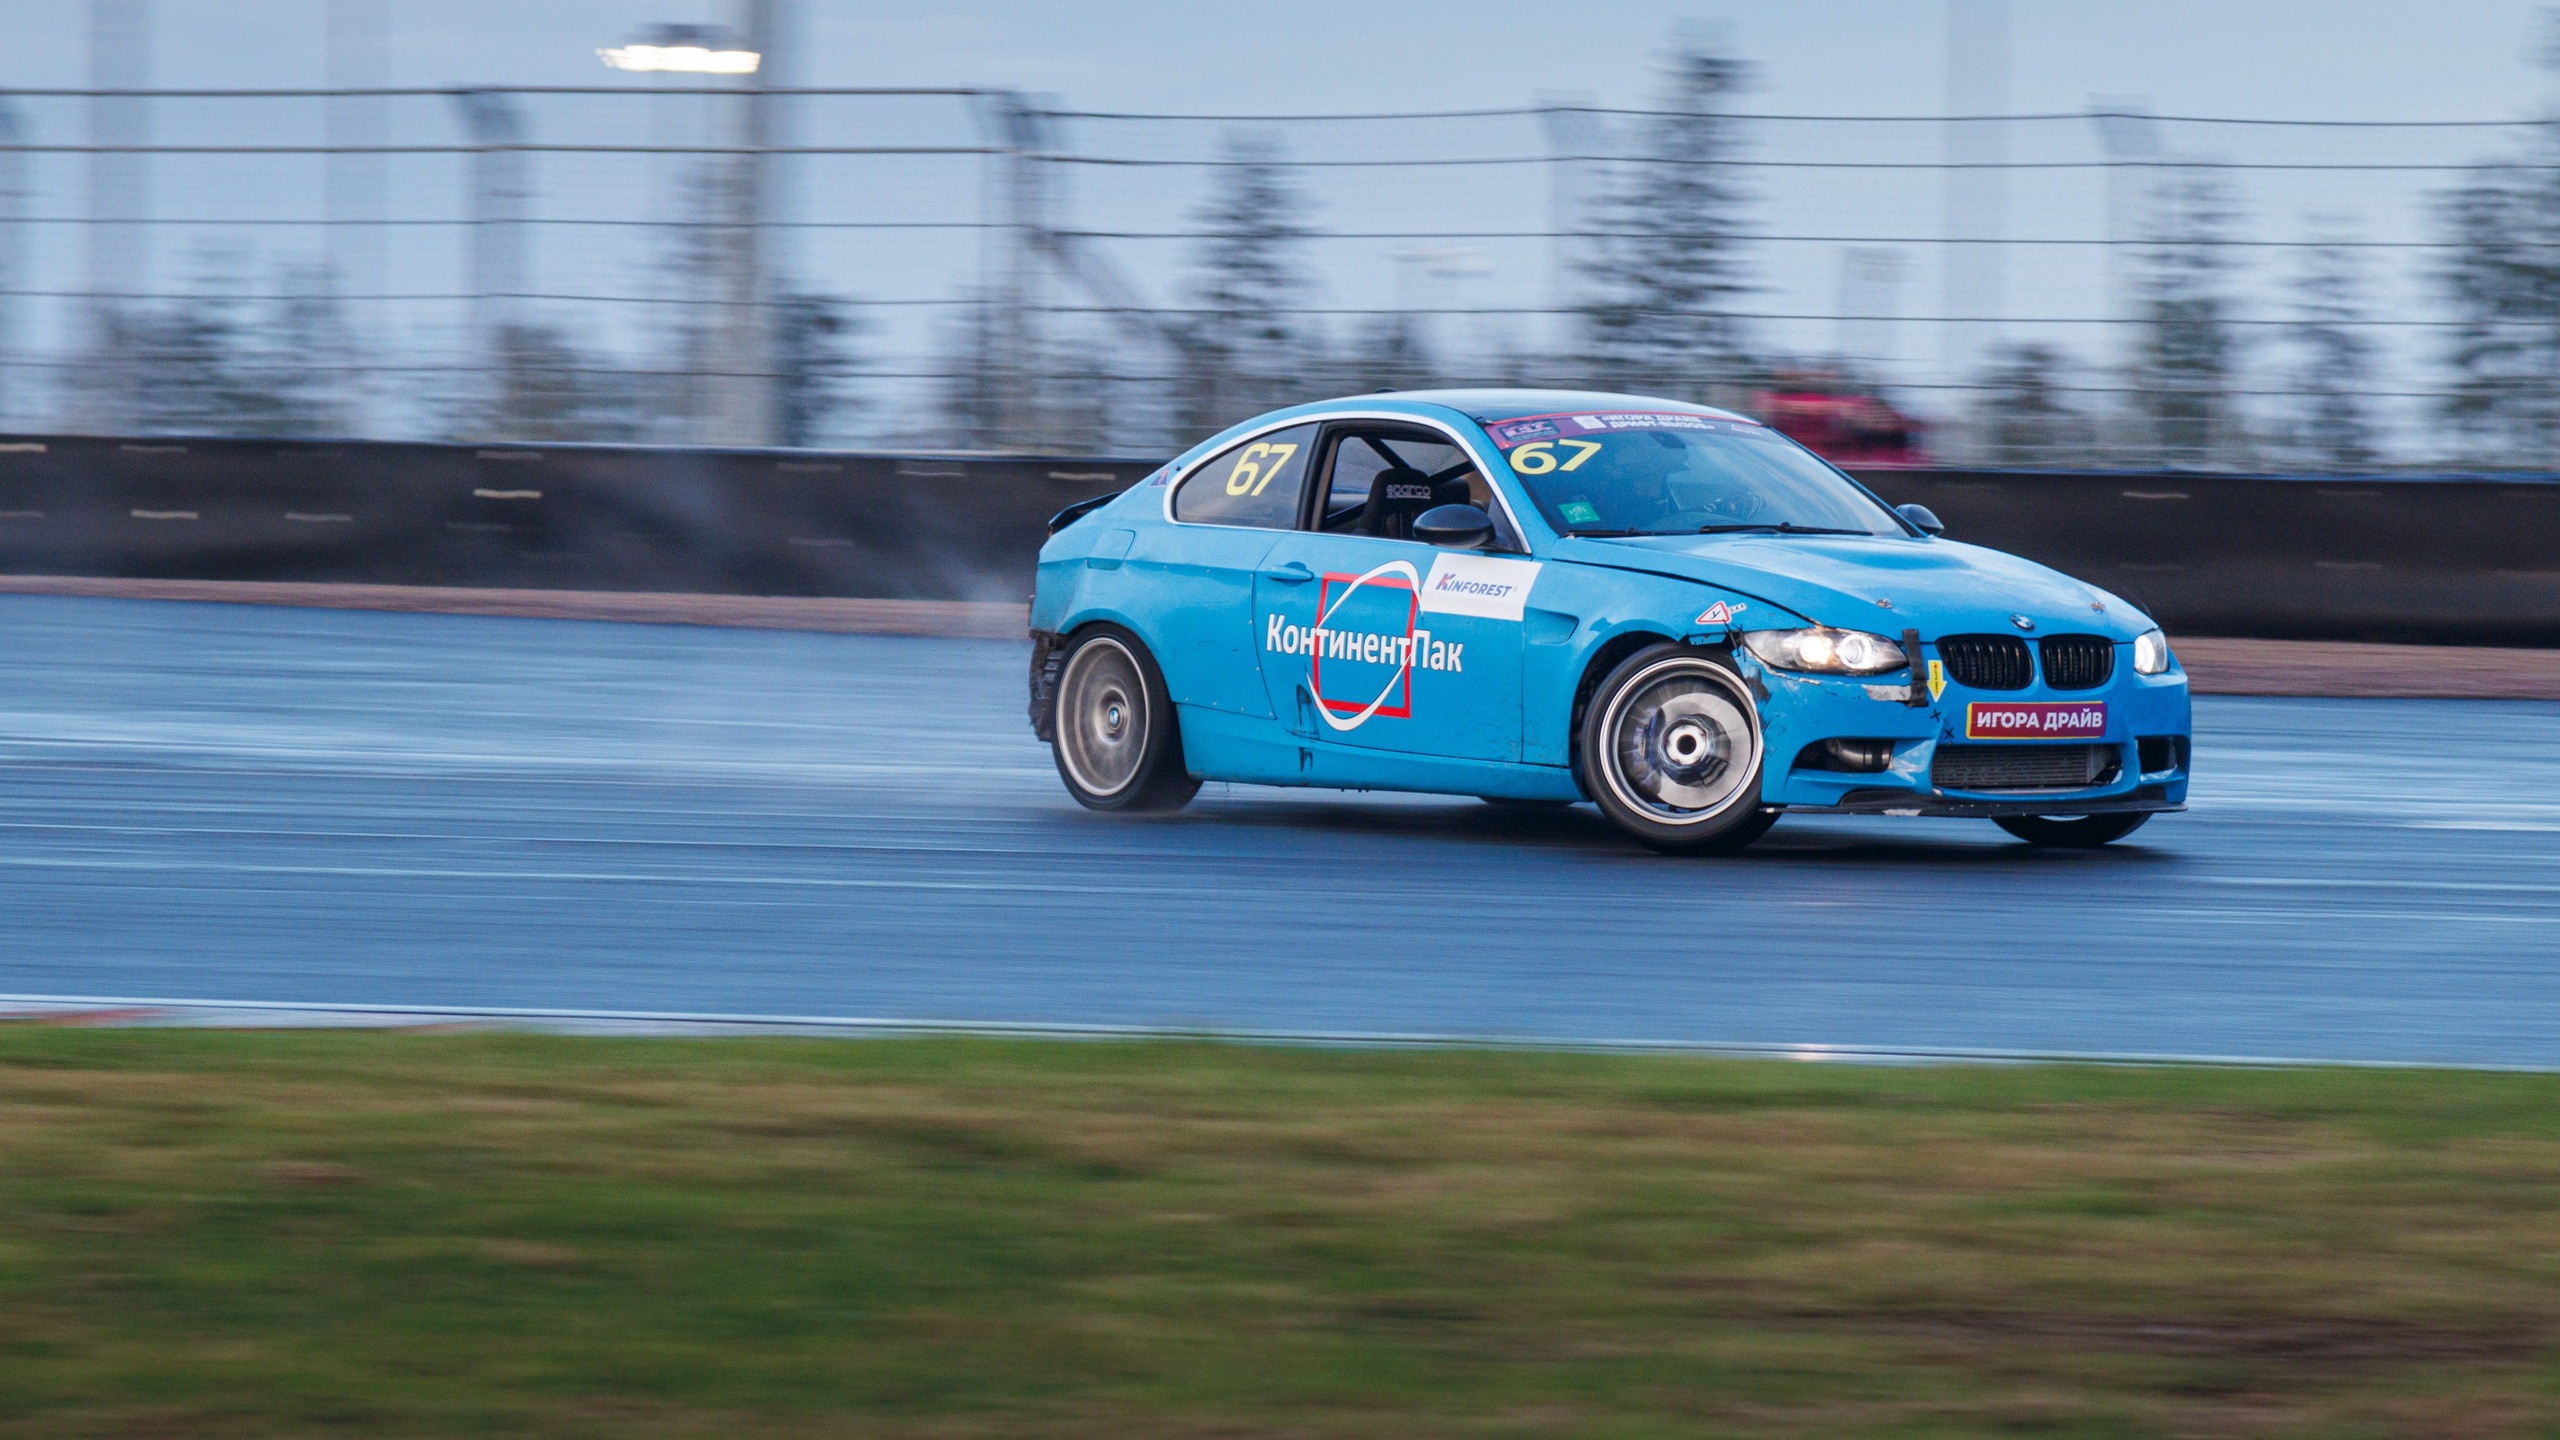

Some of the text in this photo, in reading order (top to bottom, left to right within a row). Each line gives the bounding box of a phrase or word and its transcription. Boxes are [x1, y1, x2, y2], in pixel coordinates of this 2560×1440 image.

[1225, 442, 1298, 497] 67
[1510, 438, 1602, 475] 67
[1434, 573, 1513, 597] KINFOREST
[1265, 613, 1464, 673] КонтинентПак
[1976, 707, 2103, 731] ИГОРА ДРАЙВ
